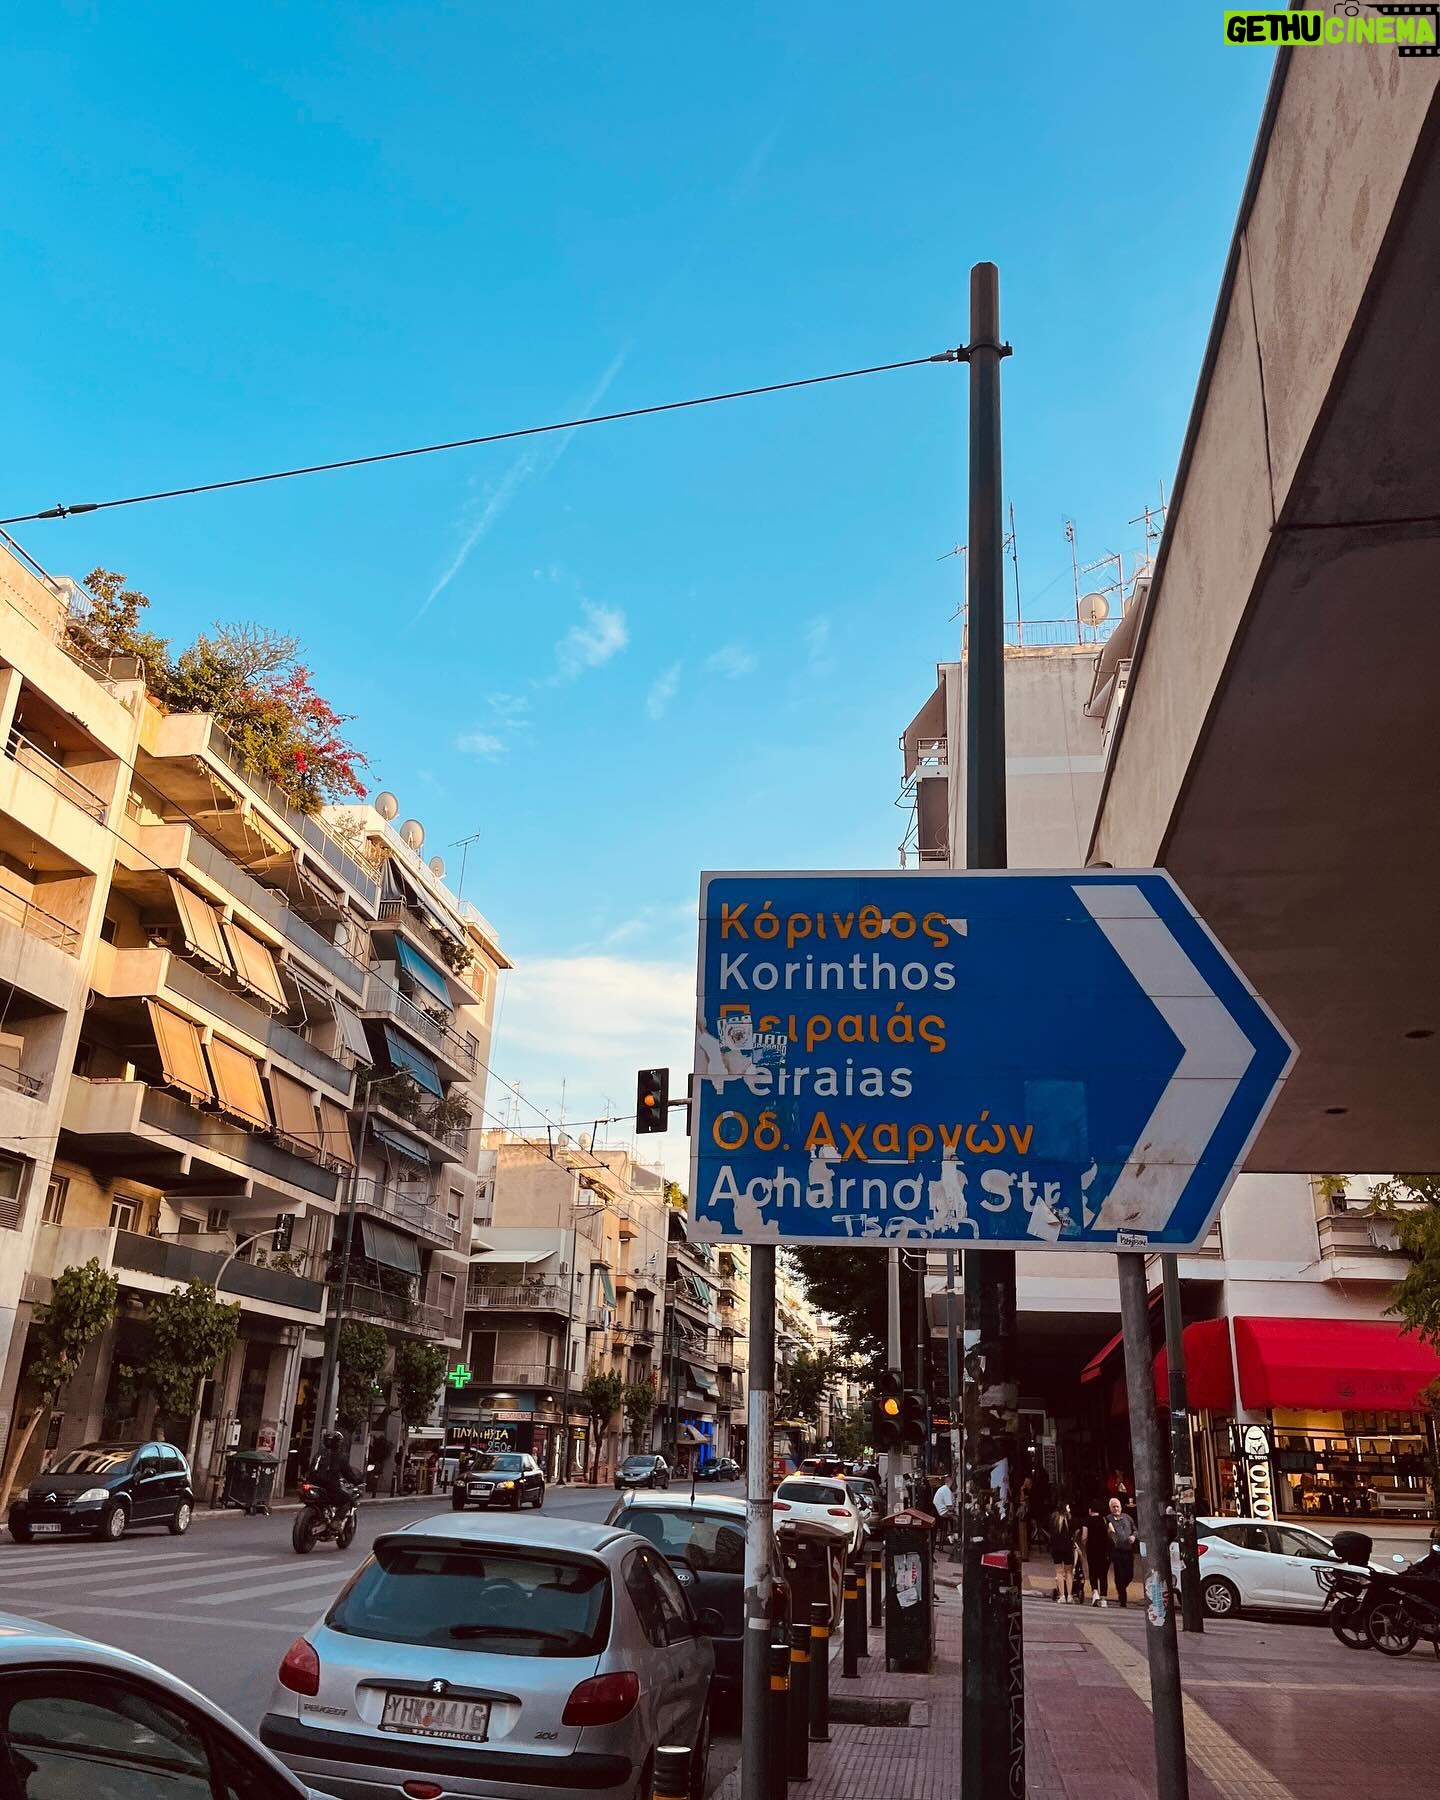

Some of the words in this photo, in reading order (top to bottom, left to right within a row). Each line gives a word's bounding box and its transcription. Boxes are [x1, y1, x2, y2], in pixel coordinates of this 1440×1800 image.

[720, 900, 950, 949] Κόρινθος
[719, 952, 957, 991] Korinthos
[716, 1057, 913, 1097] eiraias
[712, 1109, 790, 1151] Οδ.
[803, 1109, 1034, 1163] Αχαρνών
[303, 1703, 348, 1717] PEUGEOT
[534, 1731, 559, 1740] 206
